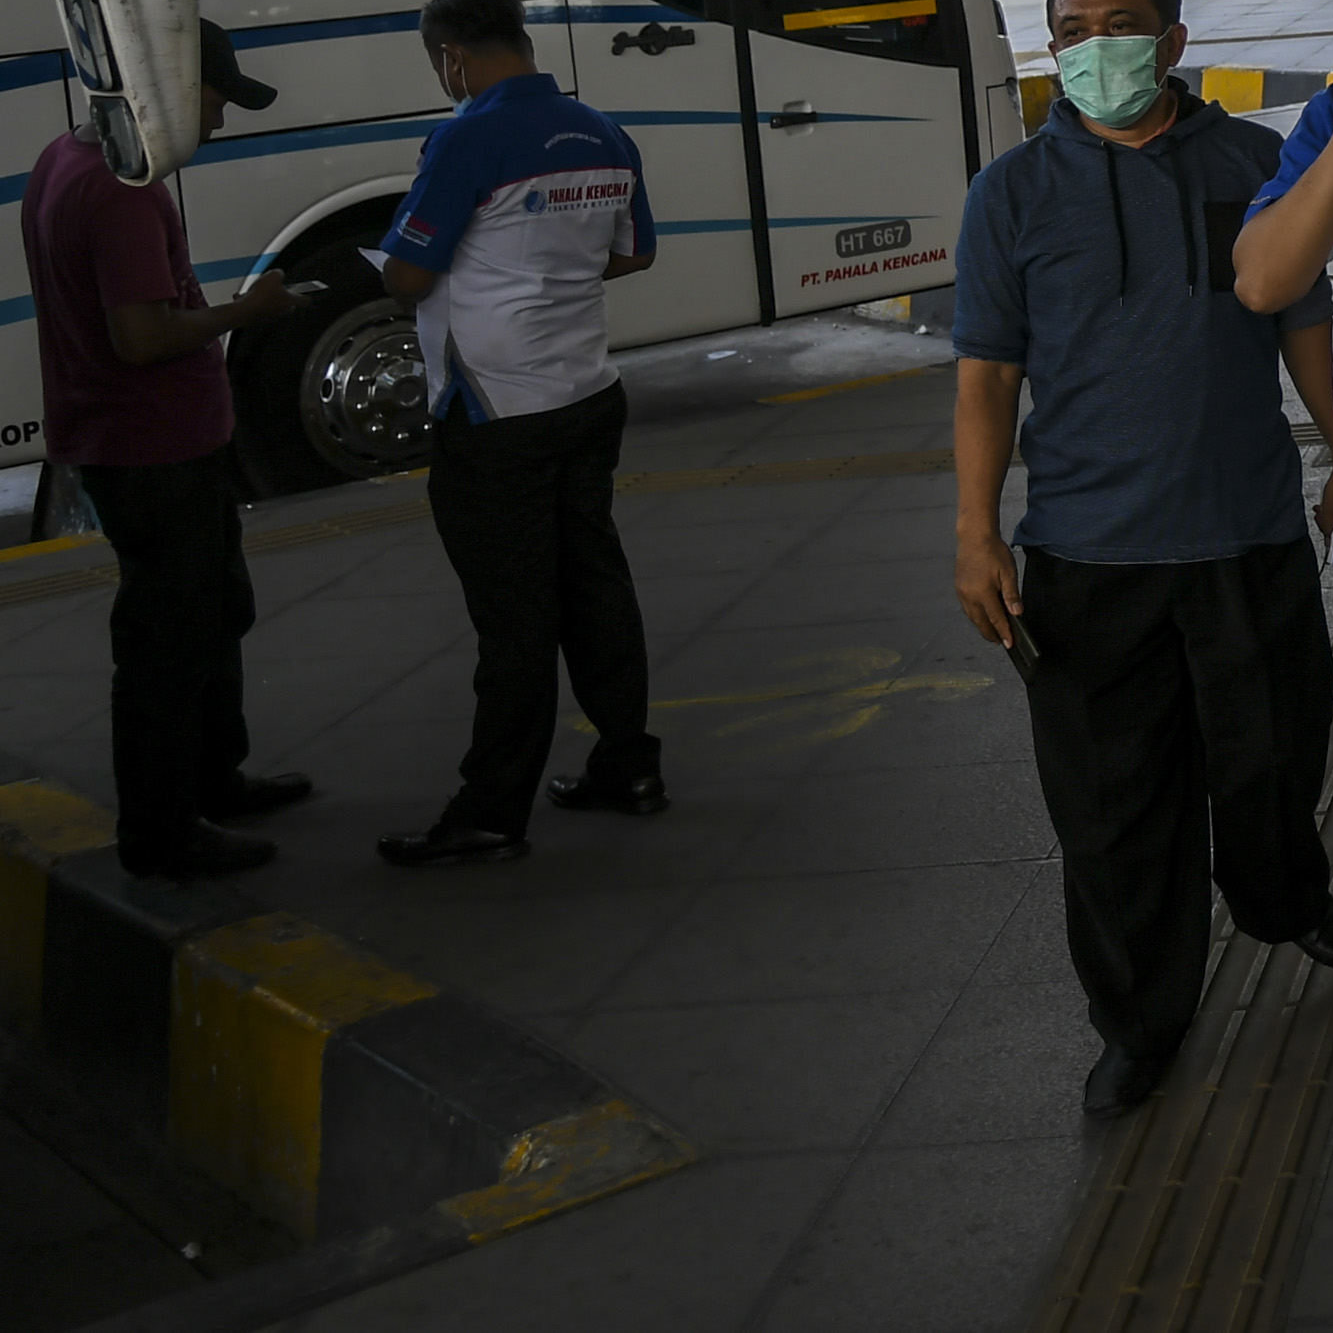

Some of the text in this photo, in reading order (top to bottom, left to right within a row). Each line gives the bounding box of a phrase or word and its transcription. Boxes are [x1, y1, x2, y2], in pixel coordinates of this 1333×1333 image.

[548, 182, 629, 204] PAHALA KENCANA
[840, 226, 904, 253] HT 667
[801, 248, 947, 287] PT. PAHALA KENCANA
